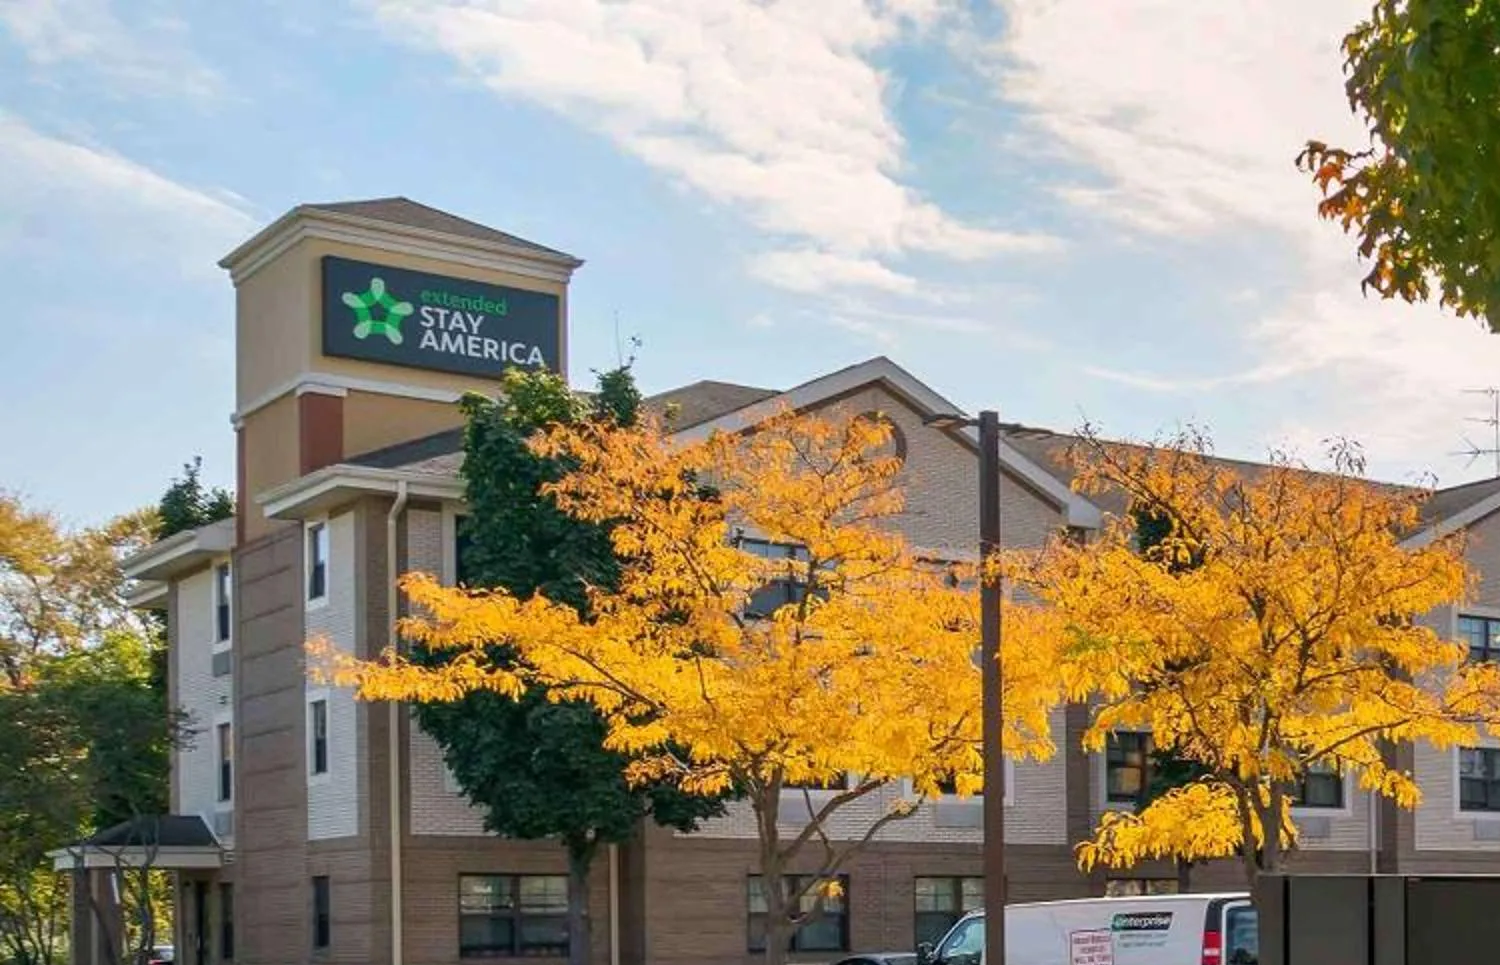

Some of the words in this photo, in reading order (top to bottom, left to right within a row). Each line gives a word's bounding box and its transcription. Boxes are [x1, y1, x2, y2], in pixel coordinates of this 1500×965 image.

[420, 290, 507, 316] extended
[420, 305, 485, 335] STAY
[419, 329, 545, 366] AMERICA
[1113, 914, 1171, 929] enterprise
